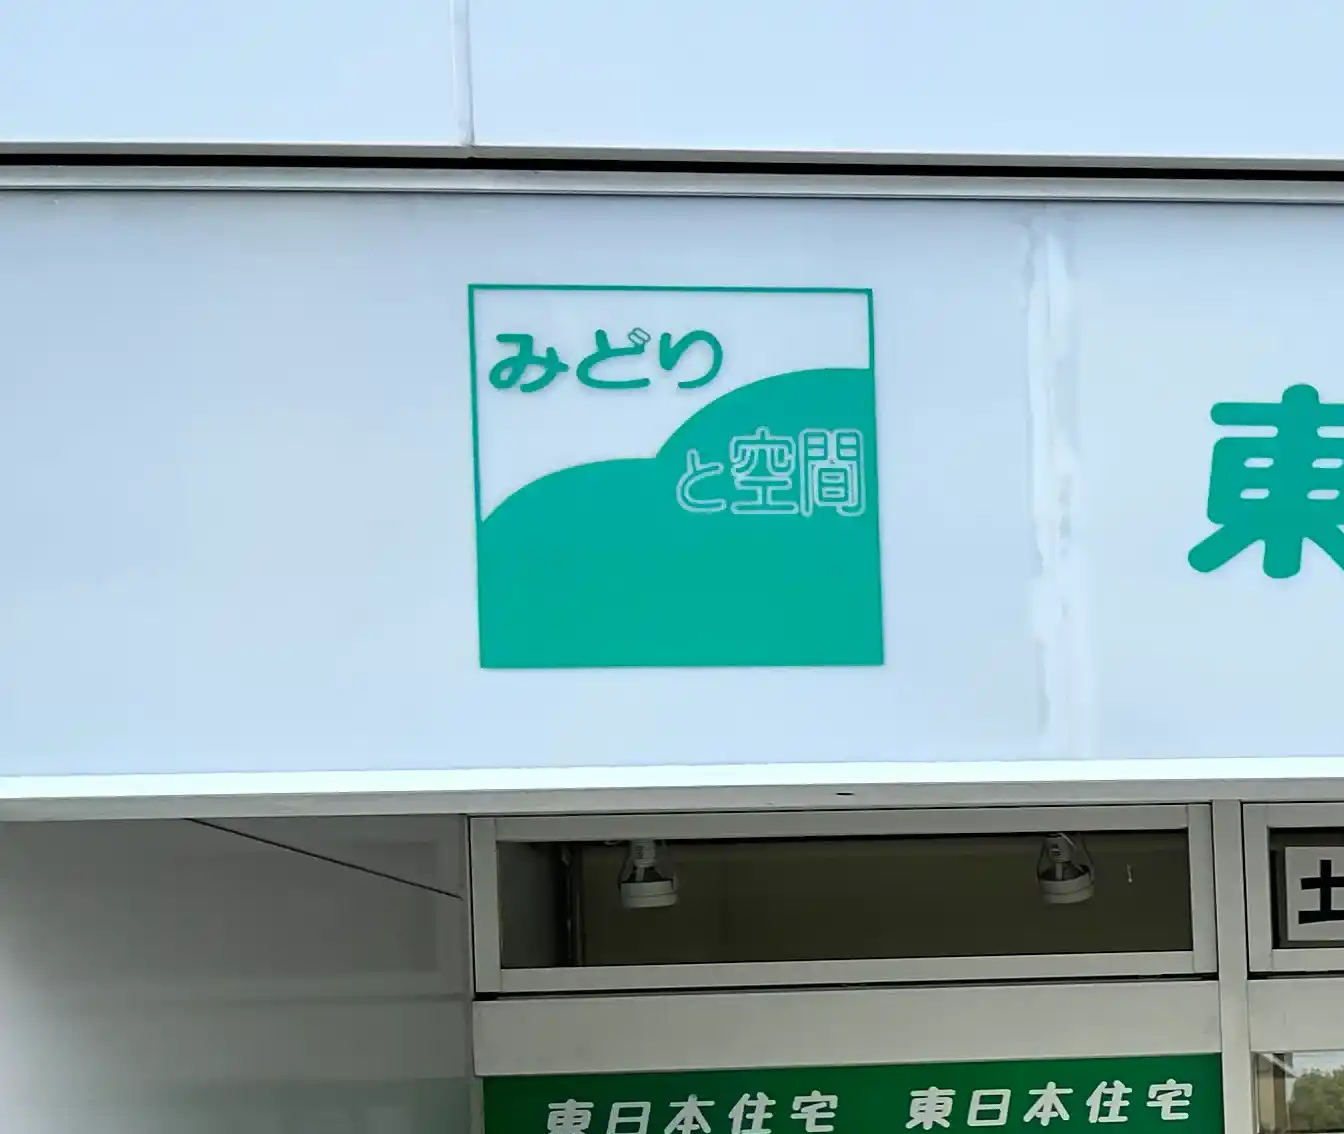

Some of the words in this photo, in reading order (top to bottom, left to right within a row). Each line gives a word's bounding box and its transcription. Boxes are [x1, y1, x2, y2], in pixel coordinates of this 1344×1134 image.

[489, 327, 723, 393] みどり
[676, 426, 866, 517] と空間
[905, 1079, 1193, 1130] 東日本住宅
